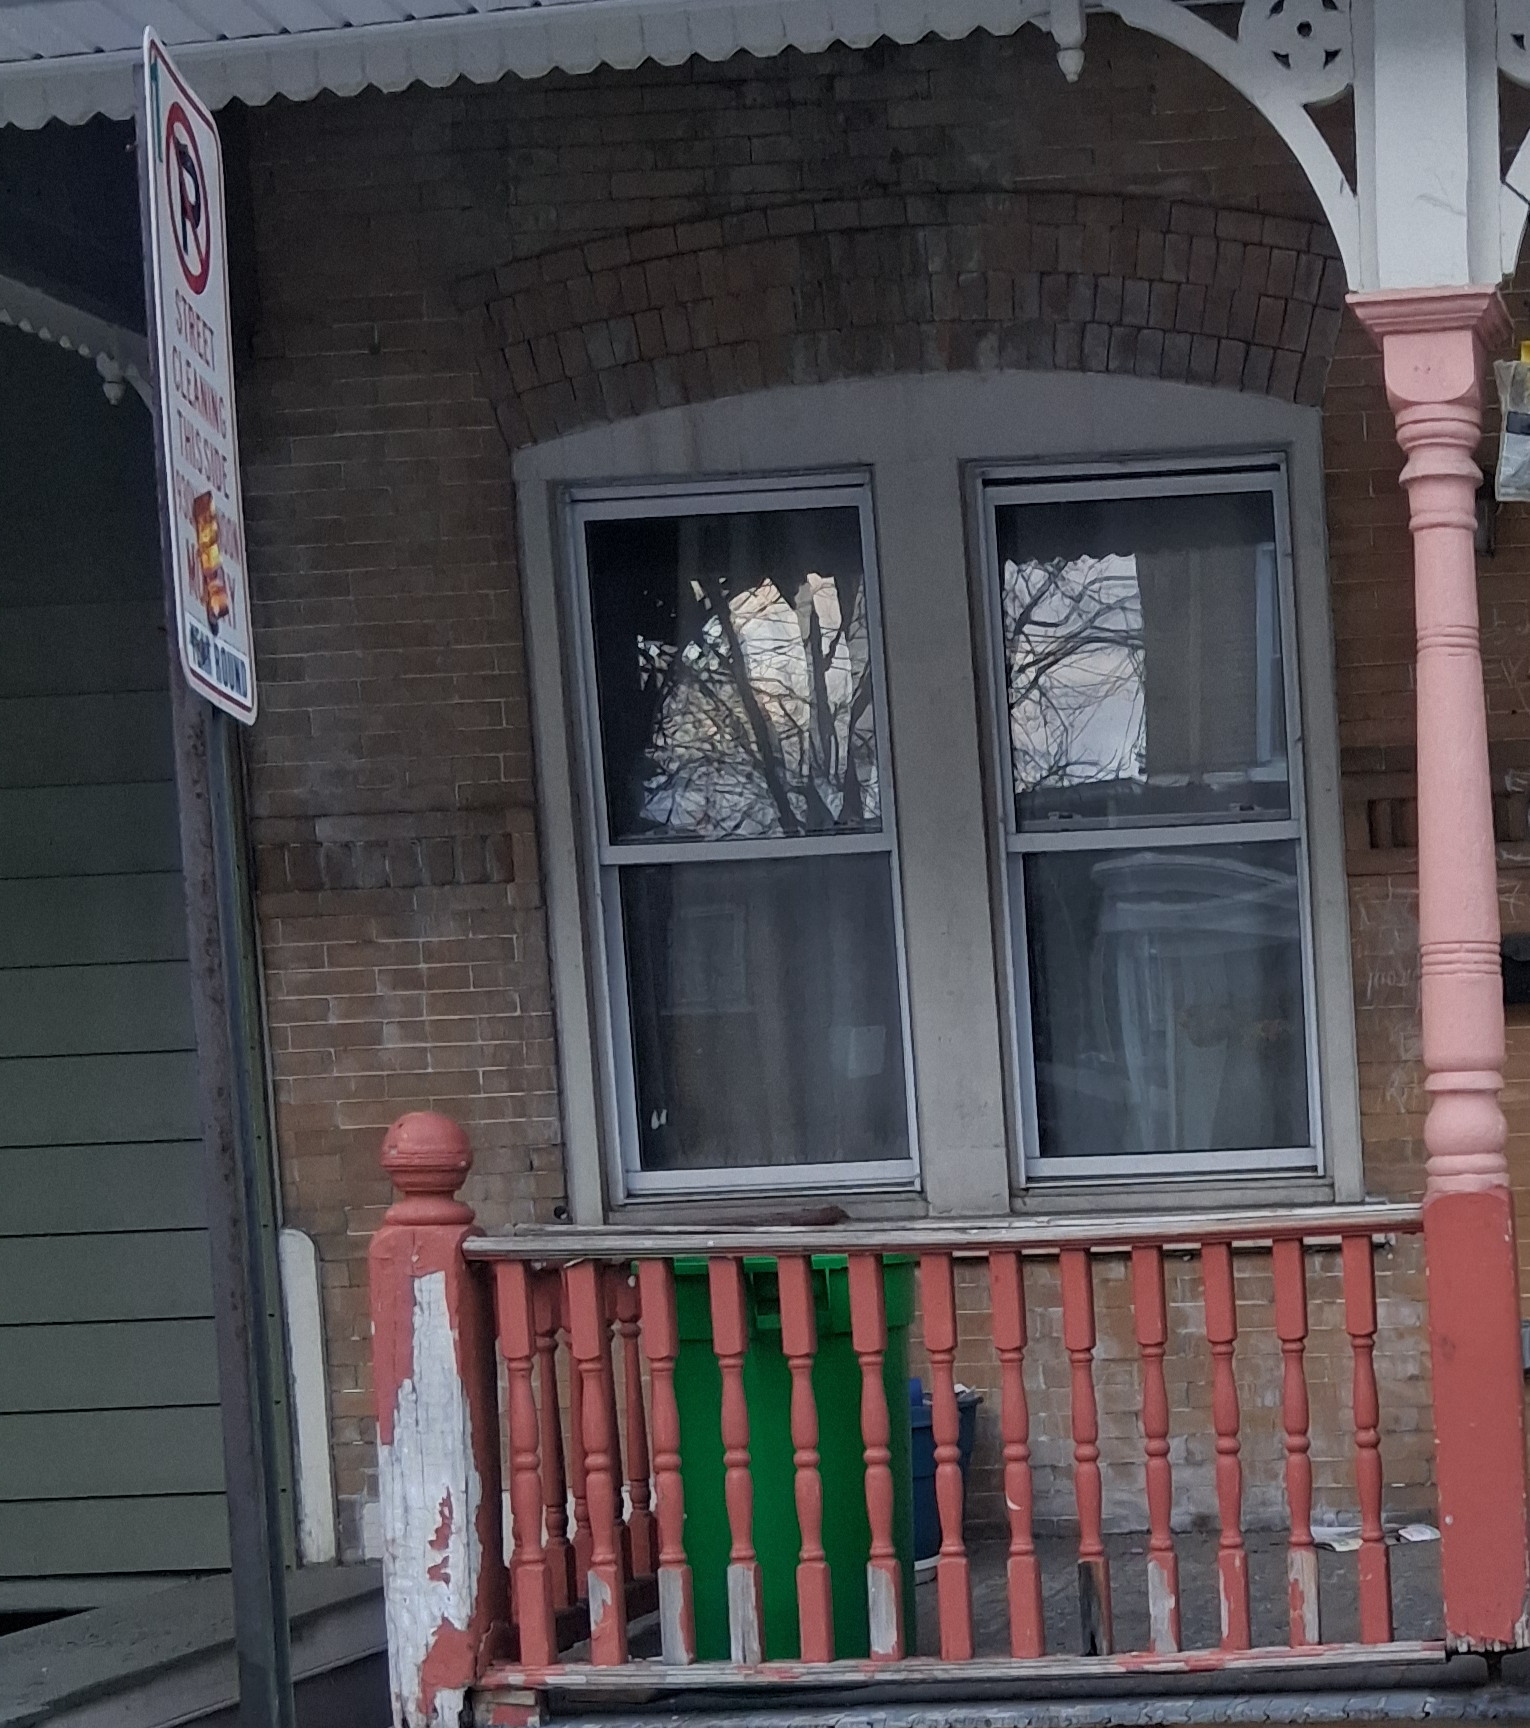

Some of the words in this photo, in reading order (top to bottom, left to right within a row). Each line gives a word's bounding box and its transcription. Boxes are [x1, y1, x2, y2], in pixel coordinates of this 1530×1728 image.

[175, 288, 215, 372] STREET
[172, 345, 227, 439] CLEANING
[177, 408, 202, 475] THIS
[203, 438, 230, 500] SIDE
